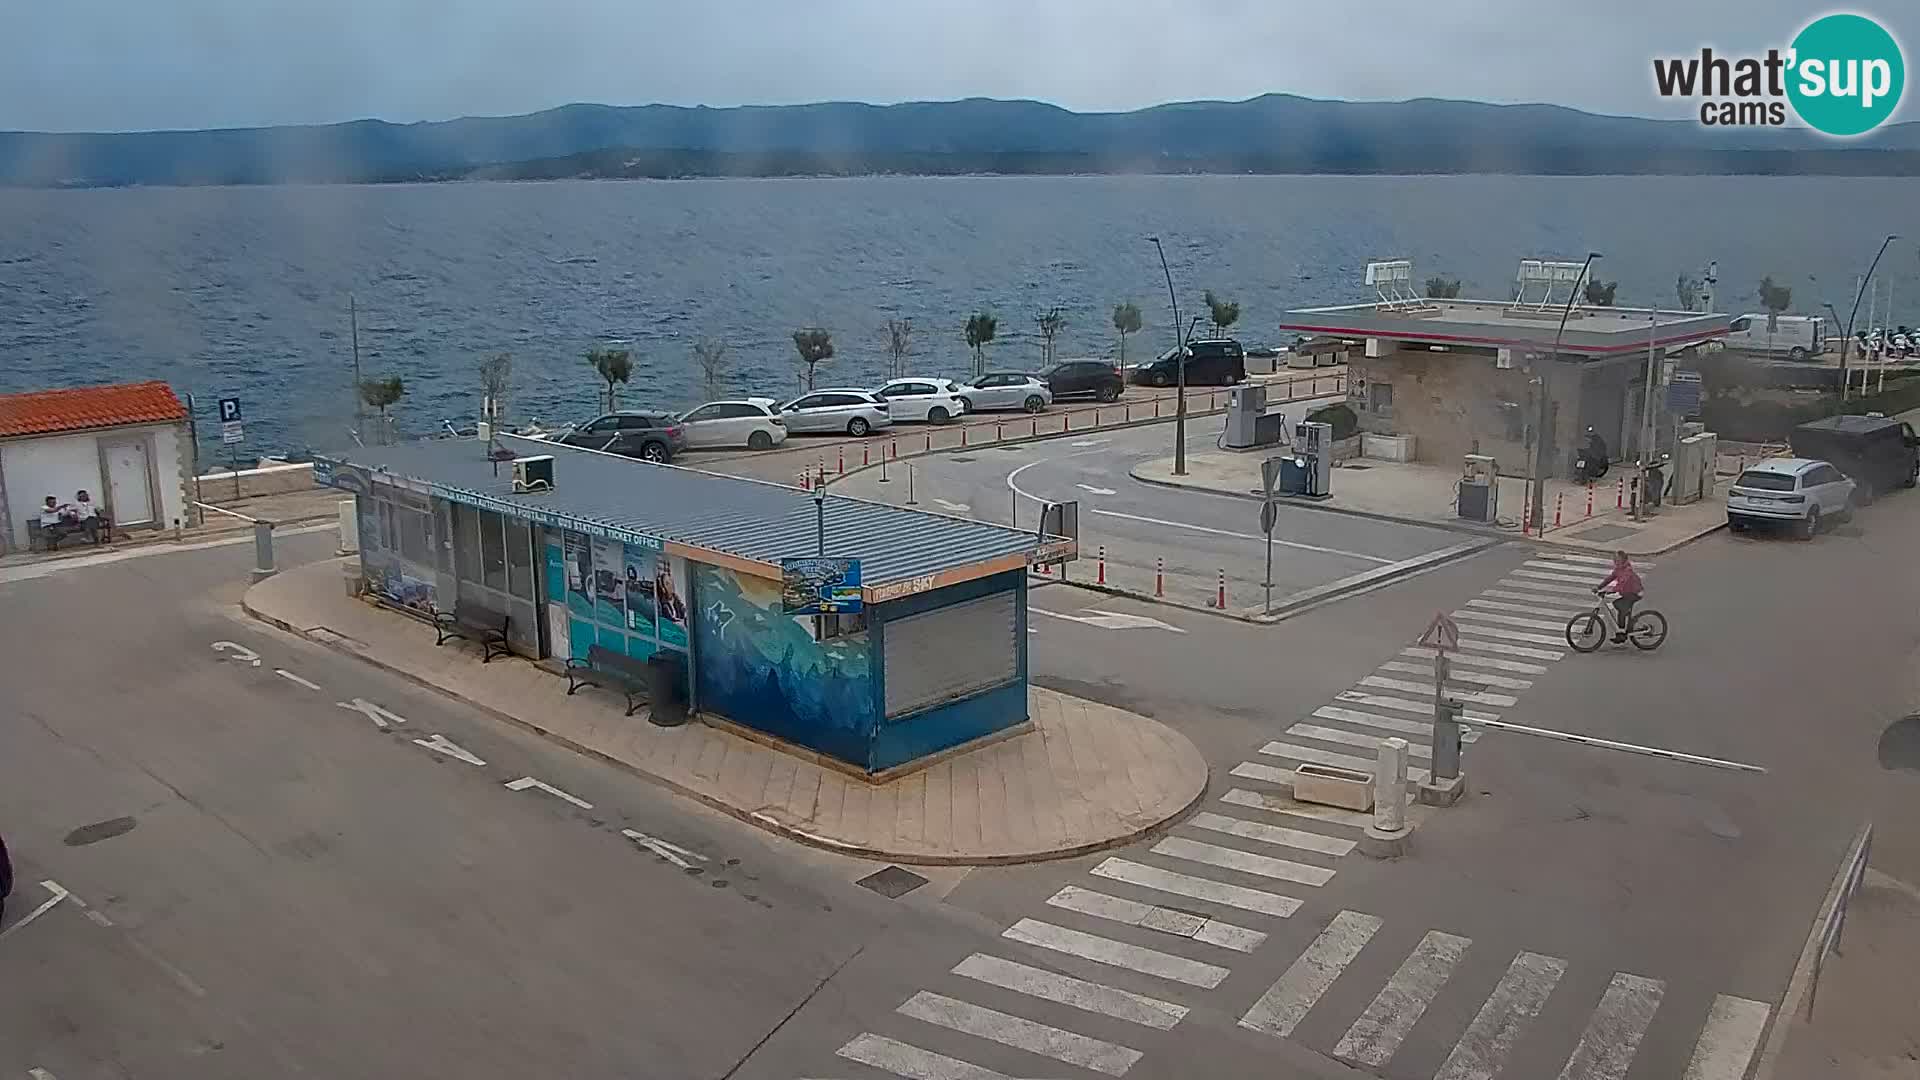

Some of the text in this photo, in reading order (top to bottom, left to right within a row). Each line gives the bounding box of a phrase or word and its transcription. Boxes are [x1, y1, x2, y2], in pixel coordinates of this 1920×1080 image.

[223, 401, 236, 419] P
[607, 528, 633, 542] TICKET
[633, 534, 660, 549] OFFICE
